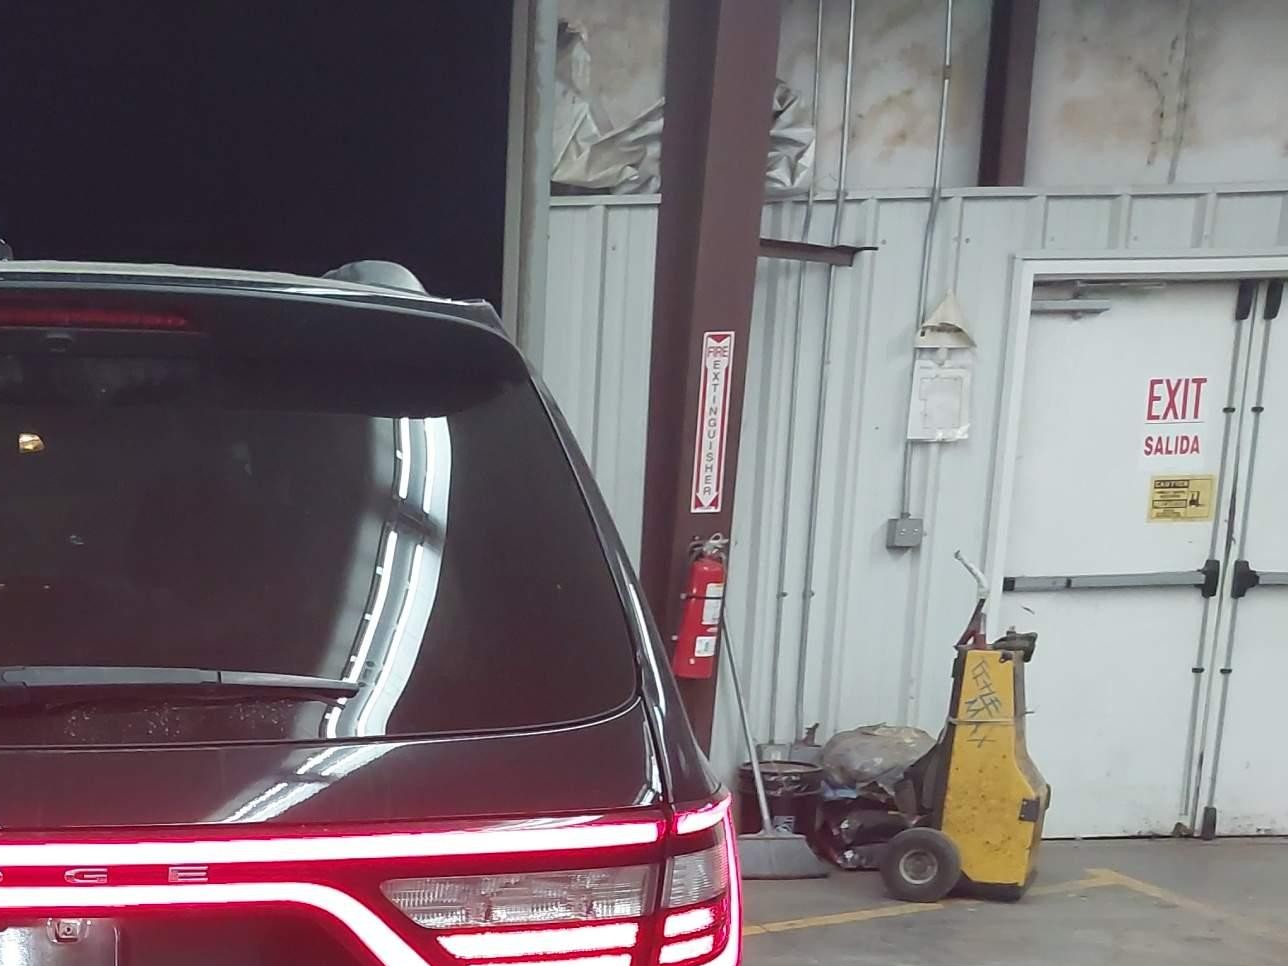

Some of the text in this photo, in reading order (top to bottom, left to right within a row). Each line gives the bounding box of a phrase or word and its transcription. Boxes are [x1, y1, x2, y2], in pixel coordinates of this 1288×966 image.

[707, 345, 729, 358] FIRE
[1146, 377, 1208, 421] EXIT
[703, 360, 721, 495] EXTINGUISHER
[1144, 435, 1200, 456] SALIDA
